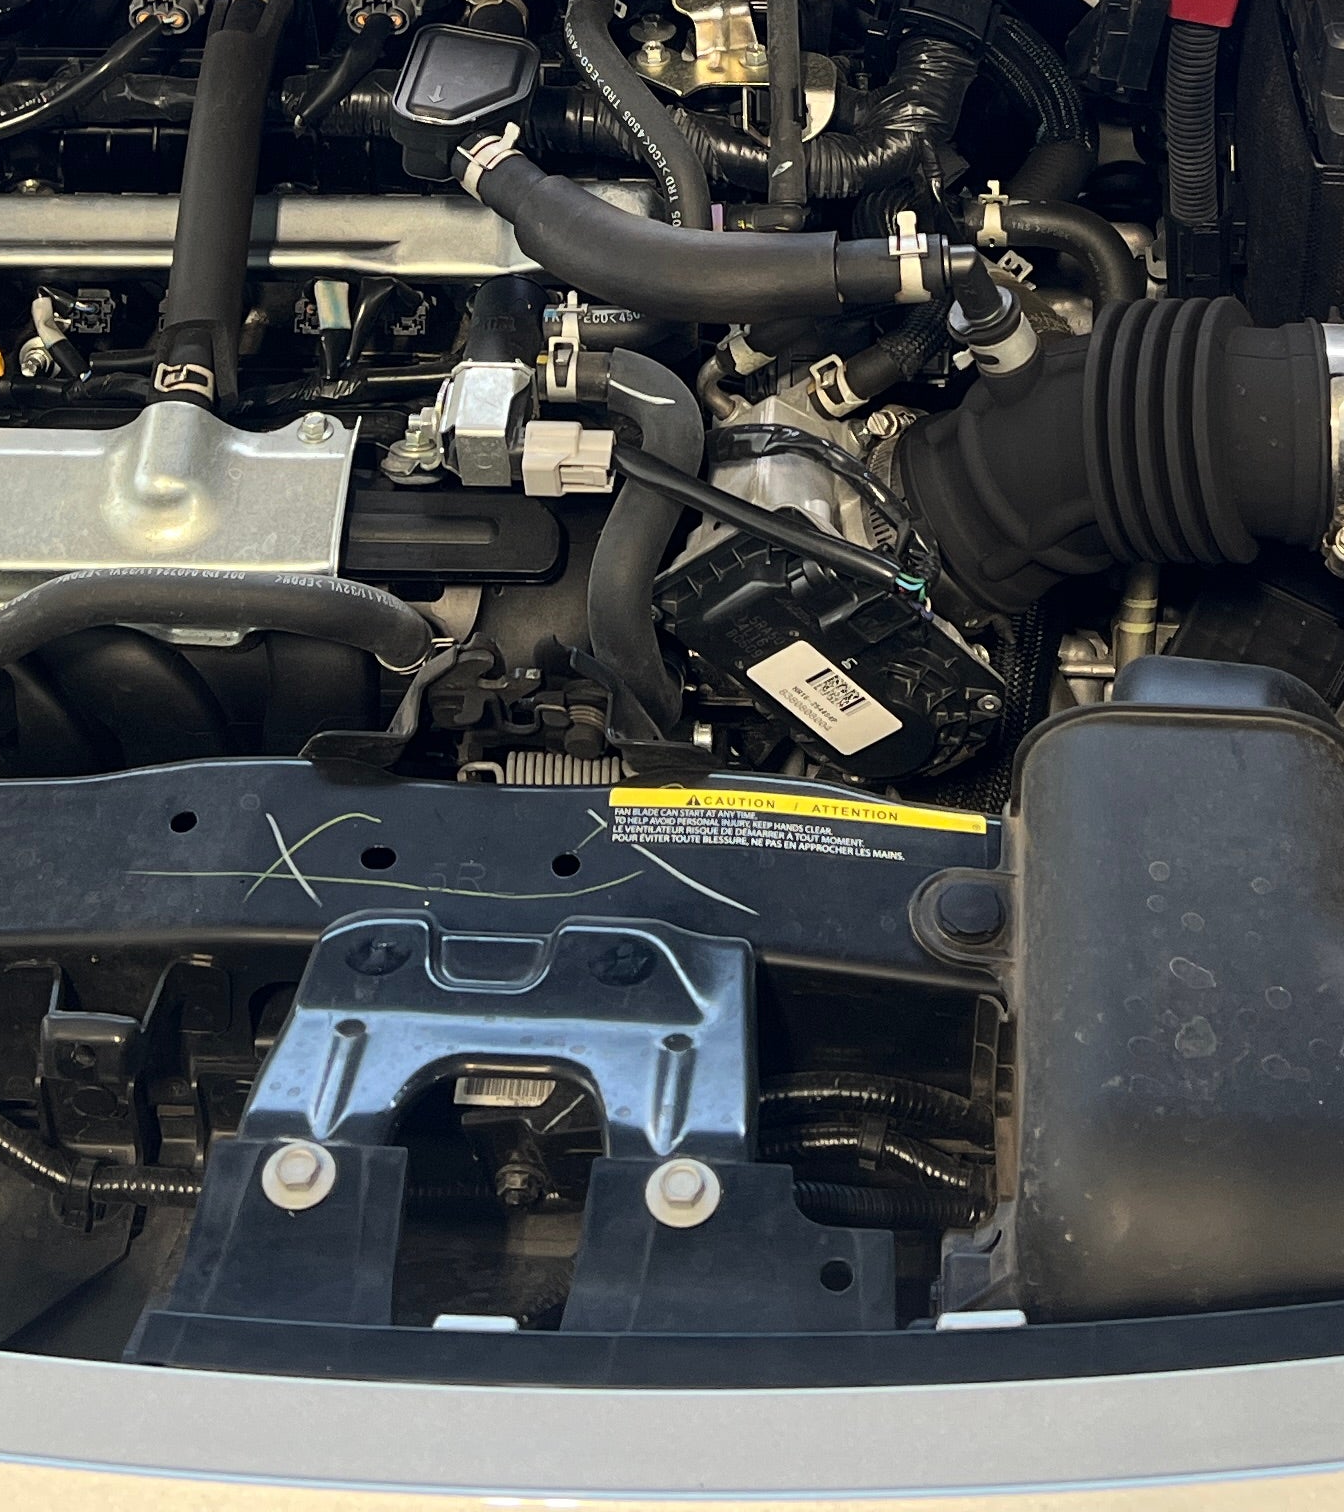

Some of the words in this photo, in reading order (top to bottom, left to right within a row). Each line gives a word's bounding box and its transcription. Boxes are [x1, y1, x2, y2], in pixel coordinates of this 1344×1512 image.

[614, 808, 631, 816] FAN
[632, 808, 659, 816] BLADE
[660, 809, 678, 817] CAN
[679, 809, 705, 818] START
[706, 810, 716, 818] AT
[717, 810, 736, 819] ANY
[704, 796, 775, 809] CAUTION
[812, 804, 898, 821] ATTENTION
[612, 825, 623, 834] LE
[624, 825, 684, 834] VENTILATEUR
[685, 826, 719, 836] RISQUE
[720, 827, 733, 836] DE
[795, 833, 820, 843] TOUT
[820, 835, 865, 848] MOMENT.
[615, 816, 626, 824] TO
[627, 816, 649, 825] HELP
[649, 817, 676, 826] AVOID
[677, 818, 720, 827] PERSONAL
[753, 820, 773, 829] KEEP
[774, 821, 803, 832] HANDS
[804, 824, 834, 835] CLEAR.
[612, 833, 638, 843] POUR
[671, 834, 701, 844] TOUTE
[750, 838, 764, 847] NE
[765, 838, 782, 848] PAS
[783, 840, 796, 850] EN
[798, 841, 854, 856] APPROCHER
[854, 847, 871, 857] LES
[872, 849, 905, 862] MAINS.
